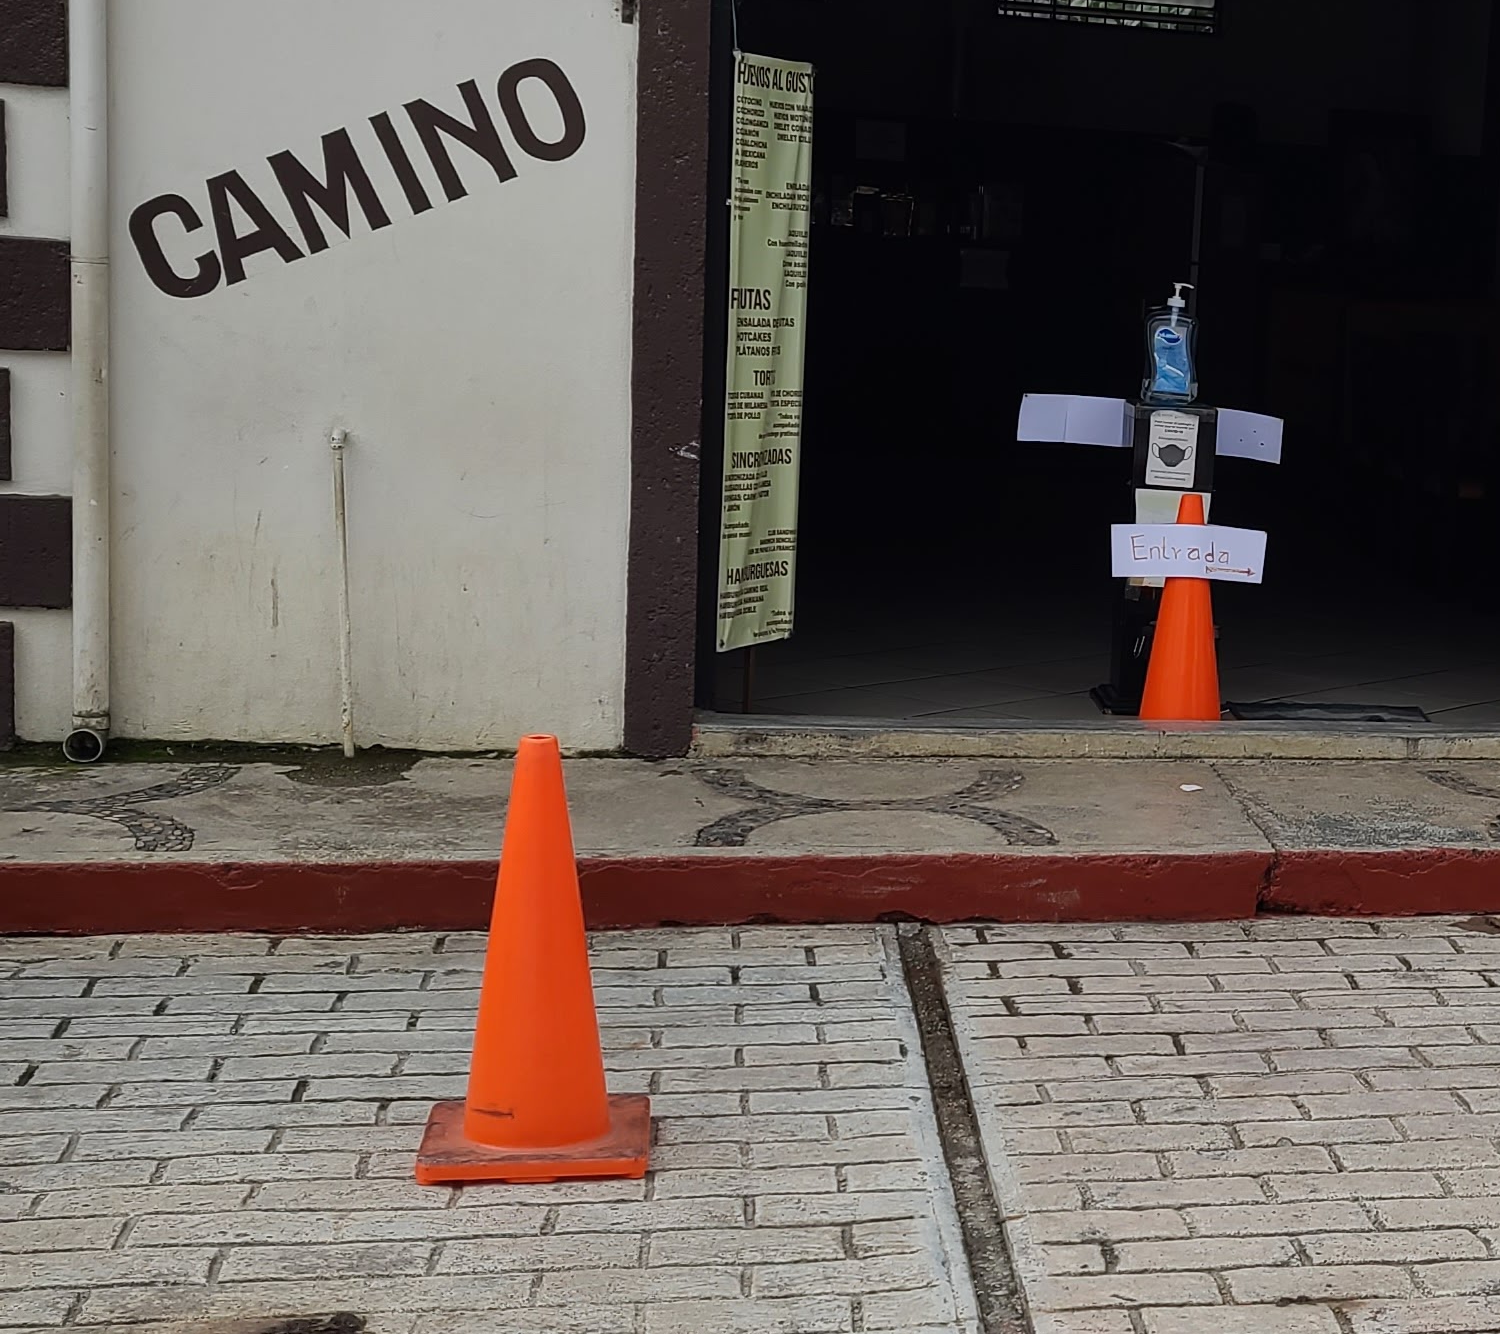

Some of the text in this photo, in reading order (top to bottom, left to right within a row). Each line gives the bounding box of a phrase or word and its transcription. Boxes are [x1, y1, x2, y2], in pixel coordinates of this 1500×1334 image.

[772, 68, 784, 91] AL
[128, 56, 587, 299] CAMINO
[1130, 534, 1230, 565] Entrada
